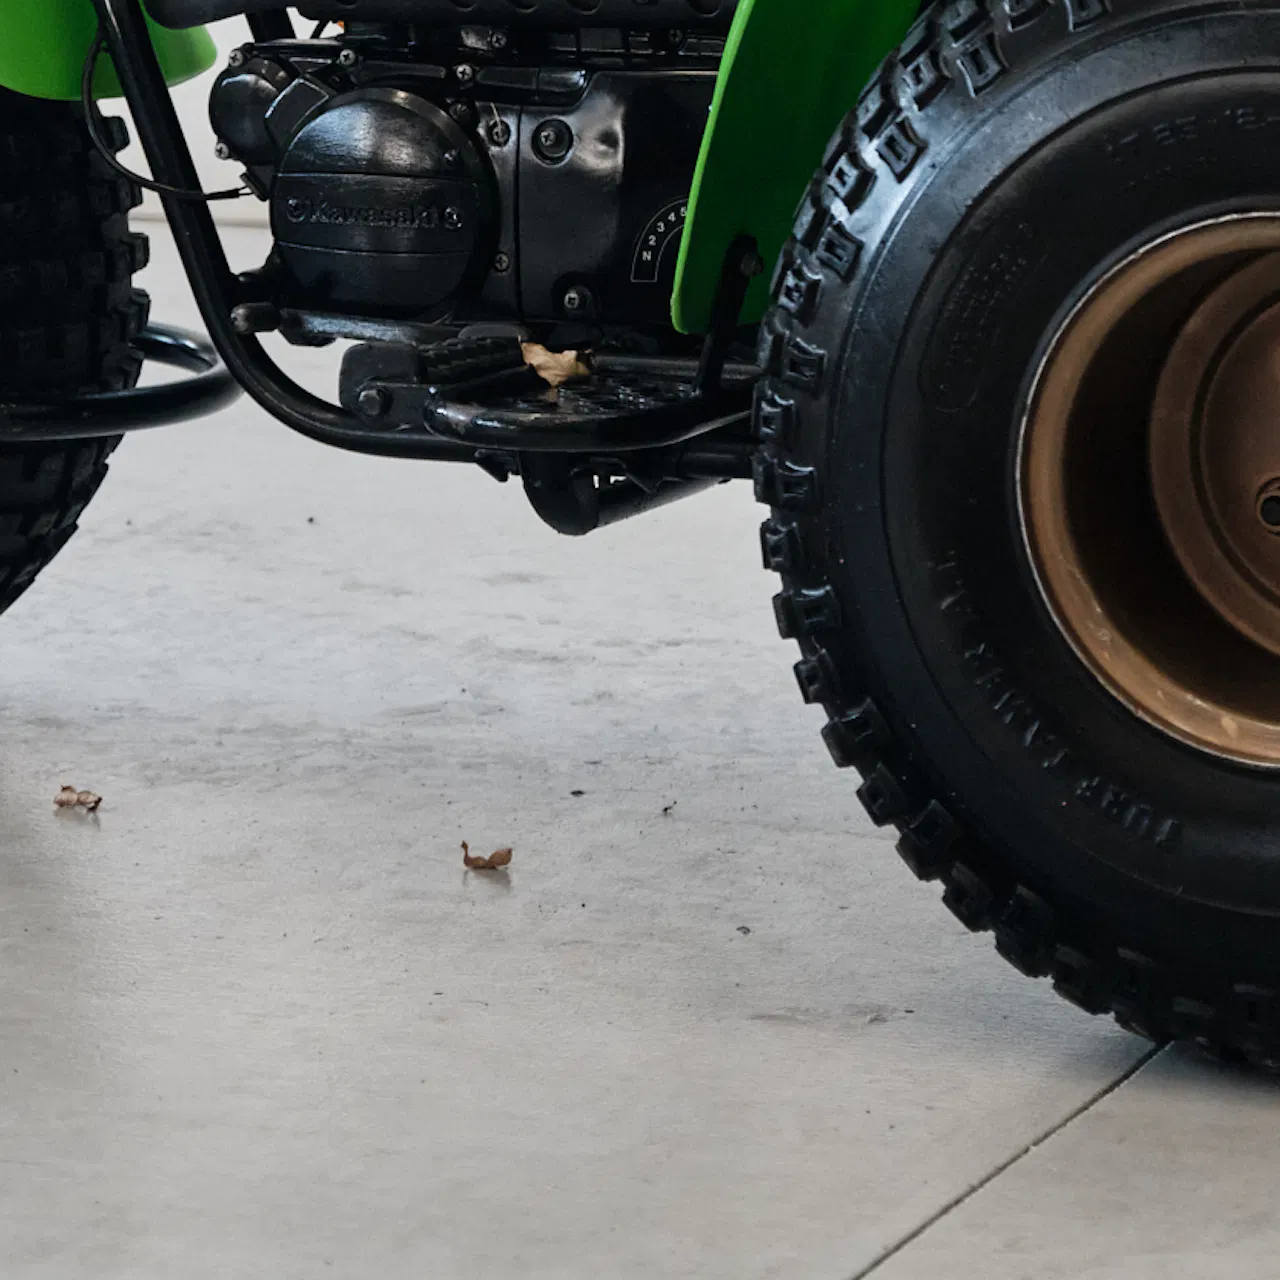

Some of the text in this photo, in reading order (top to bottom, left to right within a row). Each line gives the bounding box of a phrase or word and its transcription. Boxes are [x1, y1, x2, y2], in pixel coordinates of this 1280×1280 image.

[641, 249, 652, 261] N
[648, 234, 657, 246] 2
[656, 221, 665, 232] 3
[667, 211, 676, 222] 4
